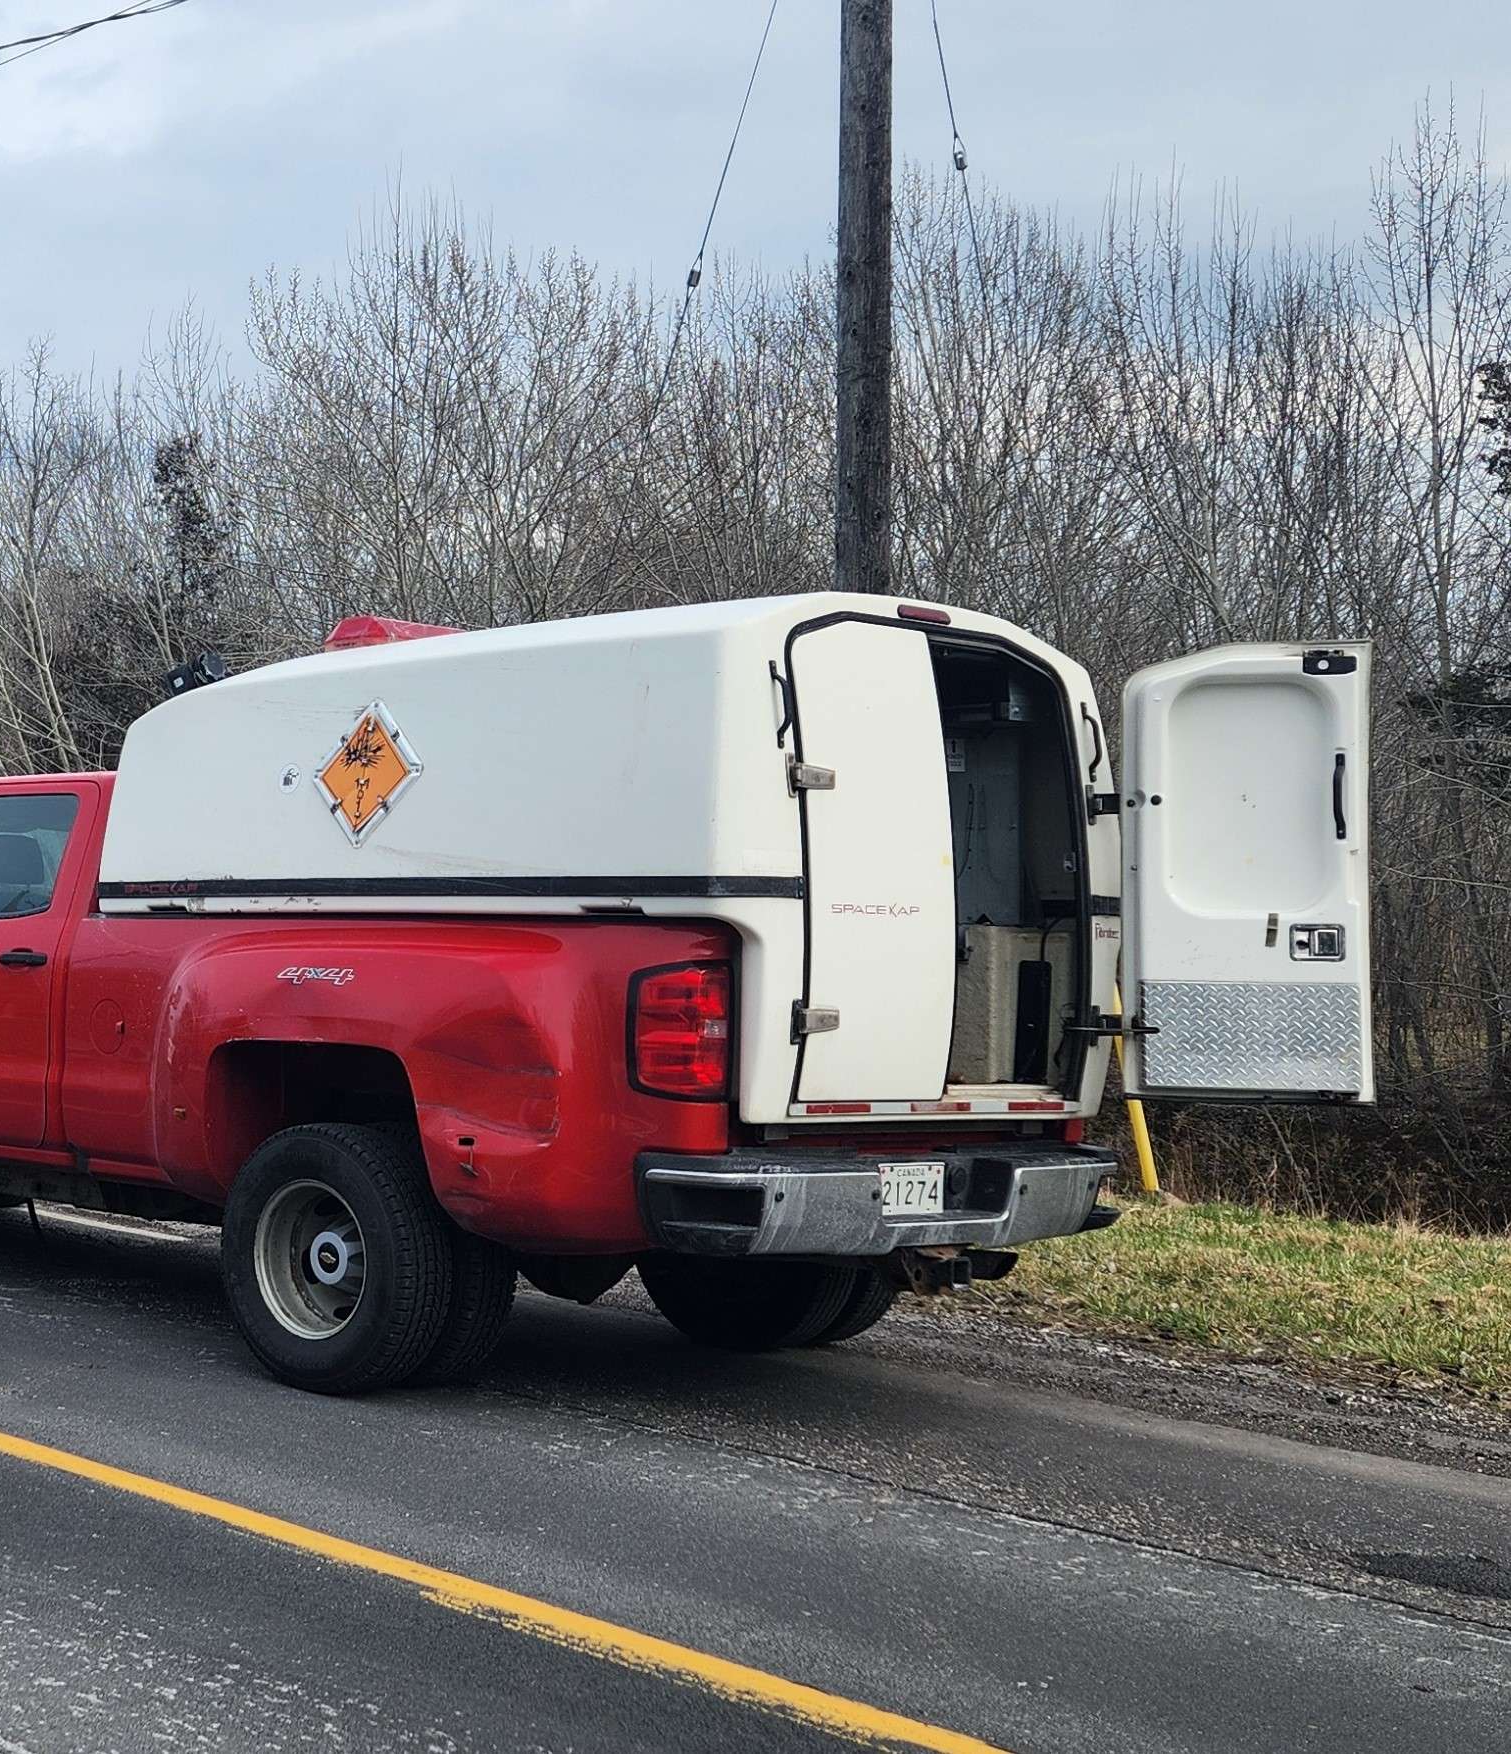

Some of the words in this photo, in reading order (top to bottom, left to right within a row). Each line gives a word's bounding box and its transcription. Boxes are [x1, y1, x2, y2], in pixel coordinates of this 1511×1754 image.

[831, 902, 921, 918] SPACEKAP
[897, 1167, 926, 1177] CANADA
[882, 1180, 938, 1206] 21274
